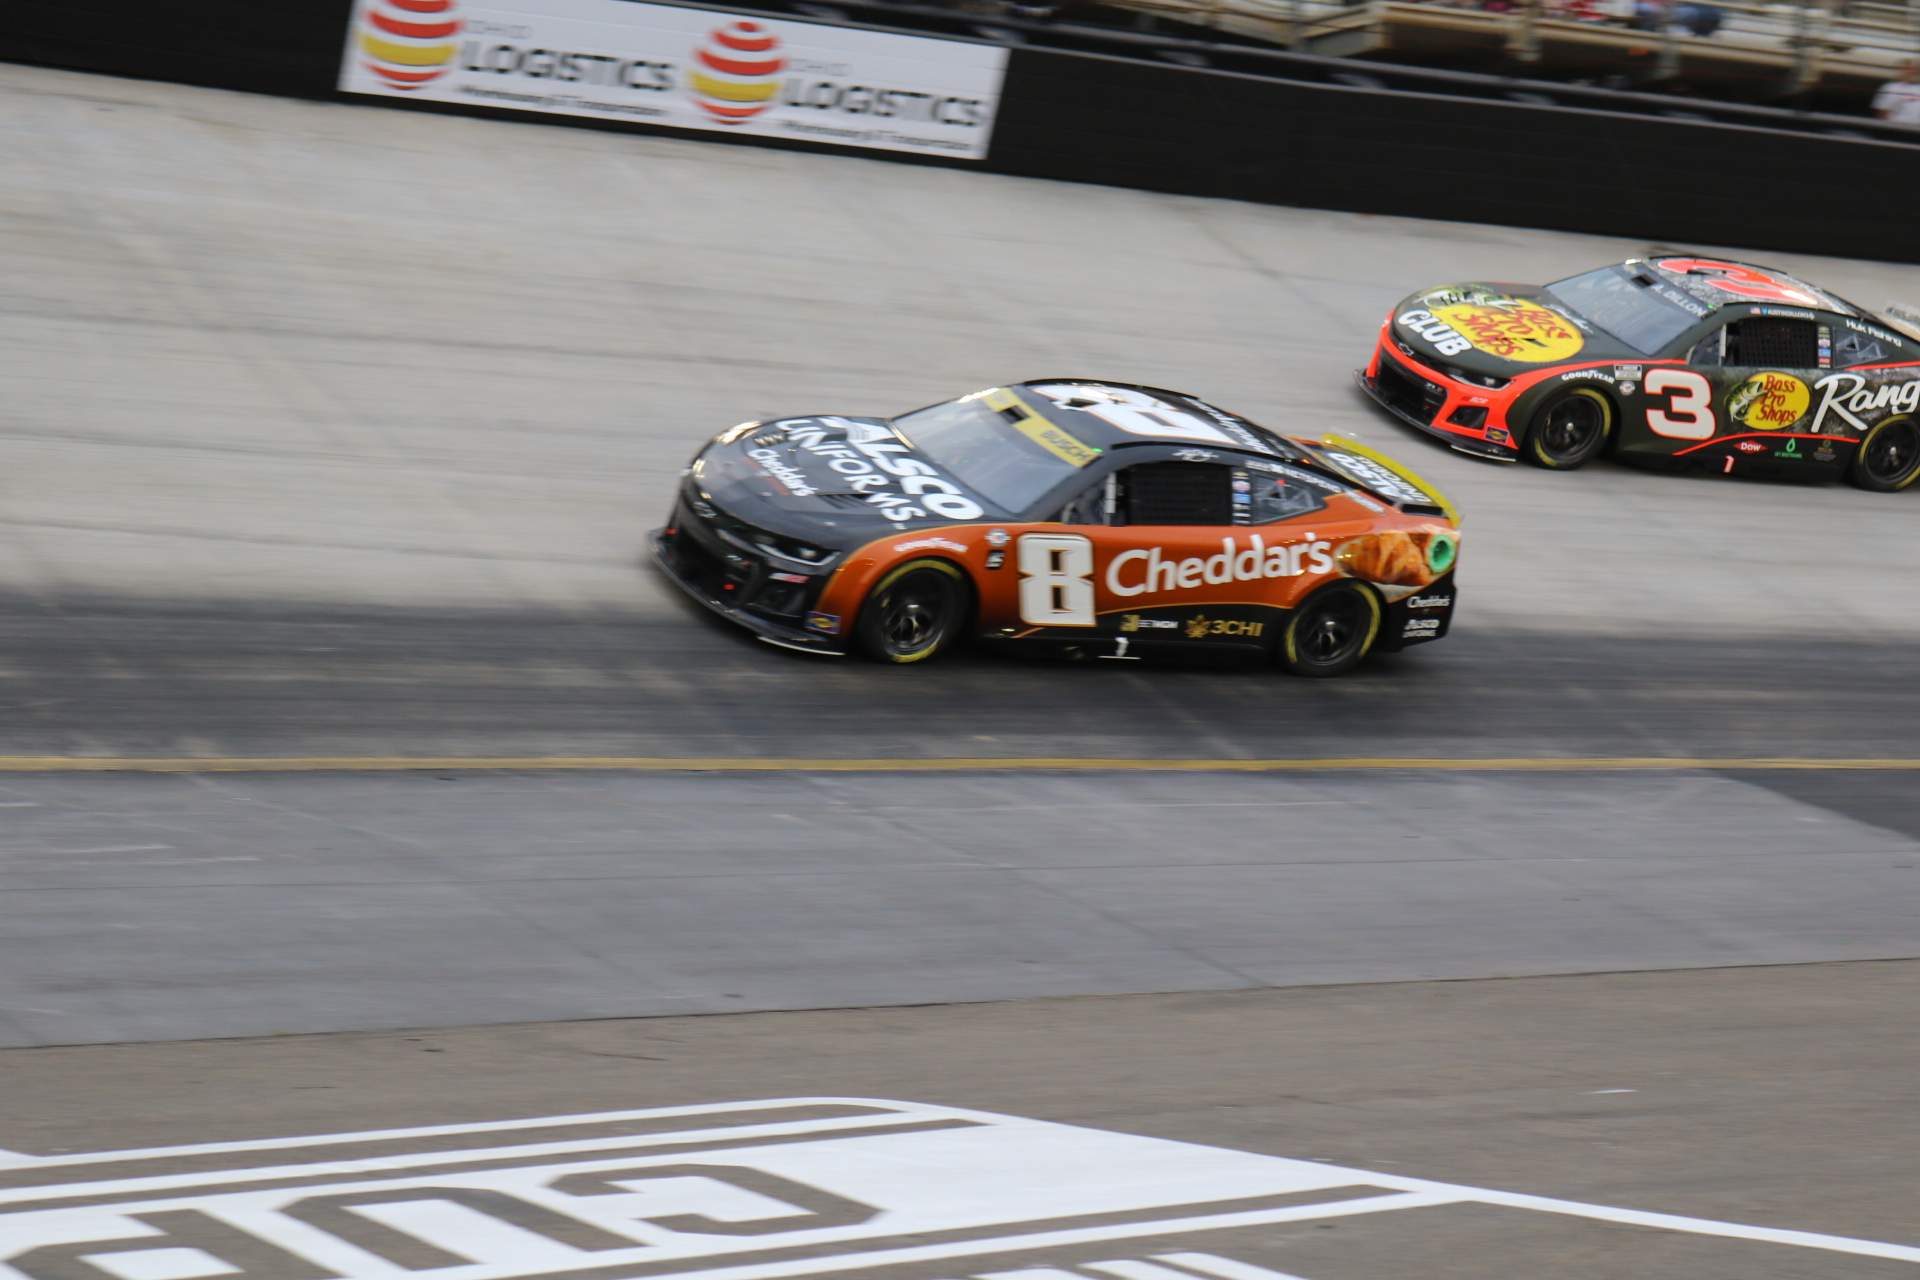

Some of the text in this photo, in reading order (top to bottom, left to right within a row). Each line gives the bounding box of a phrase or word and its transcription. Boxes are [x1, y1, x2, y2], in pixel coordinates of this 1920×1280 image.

[461, 42, 676, 92] LOGISTICS
[783, 78, 990, 127] LOGISTICS
[1663, 289, 1708, 318] DILLON
[1398, 309, 1474, 357] CLUB
[1846, 319, 1903, 348] Huk Fishing
[1561, 369, 1616, 385] GOODYEAR
[1763, 374, 1797, 393] Bass
[1644, 368, 1717, 441] 3
[1756, 405, 1798, 426] Shops
[1761, 390, 1787, 407] Pro
[1041, 430, 1094, 462] BUSCH
[747, 448, 820, 497] Cheddar's
[776, 419, 928, 522] UNIFORMS
[1018, 532, 1096, 627] 8
[1105, 533, 1334, 597] Cheddar's
[1210, 620, 1266, 637] 3CHI
